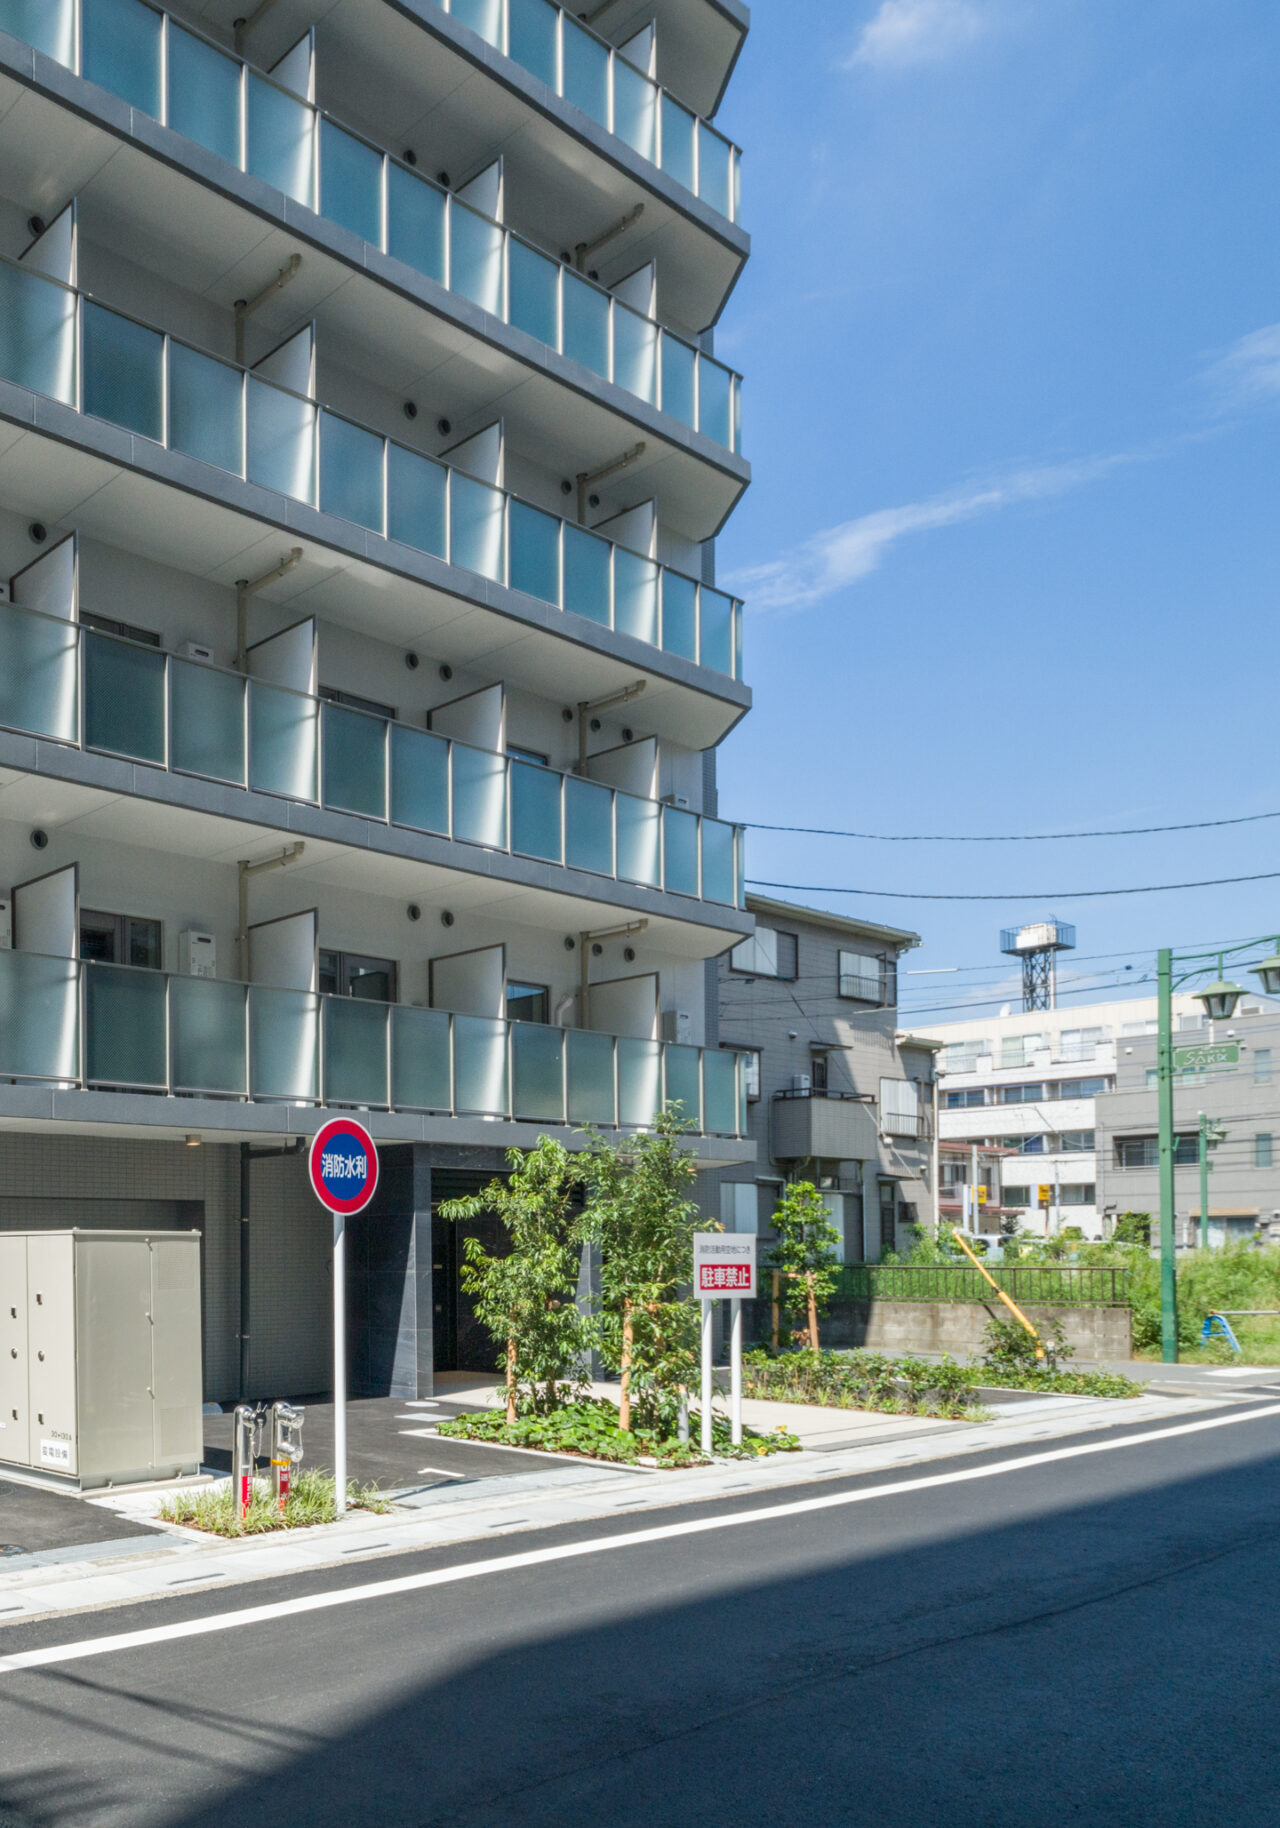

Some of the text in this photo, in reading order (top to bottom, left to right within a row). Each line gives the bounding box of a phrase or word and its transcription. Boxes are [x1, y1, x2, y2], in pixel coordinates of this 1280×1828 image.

[321, 1153, 367, 1179] 消防水利
[701, 1267, 749, 1288] 駐車禁止
